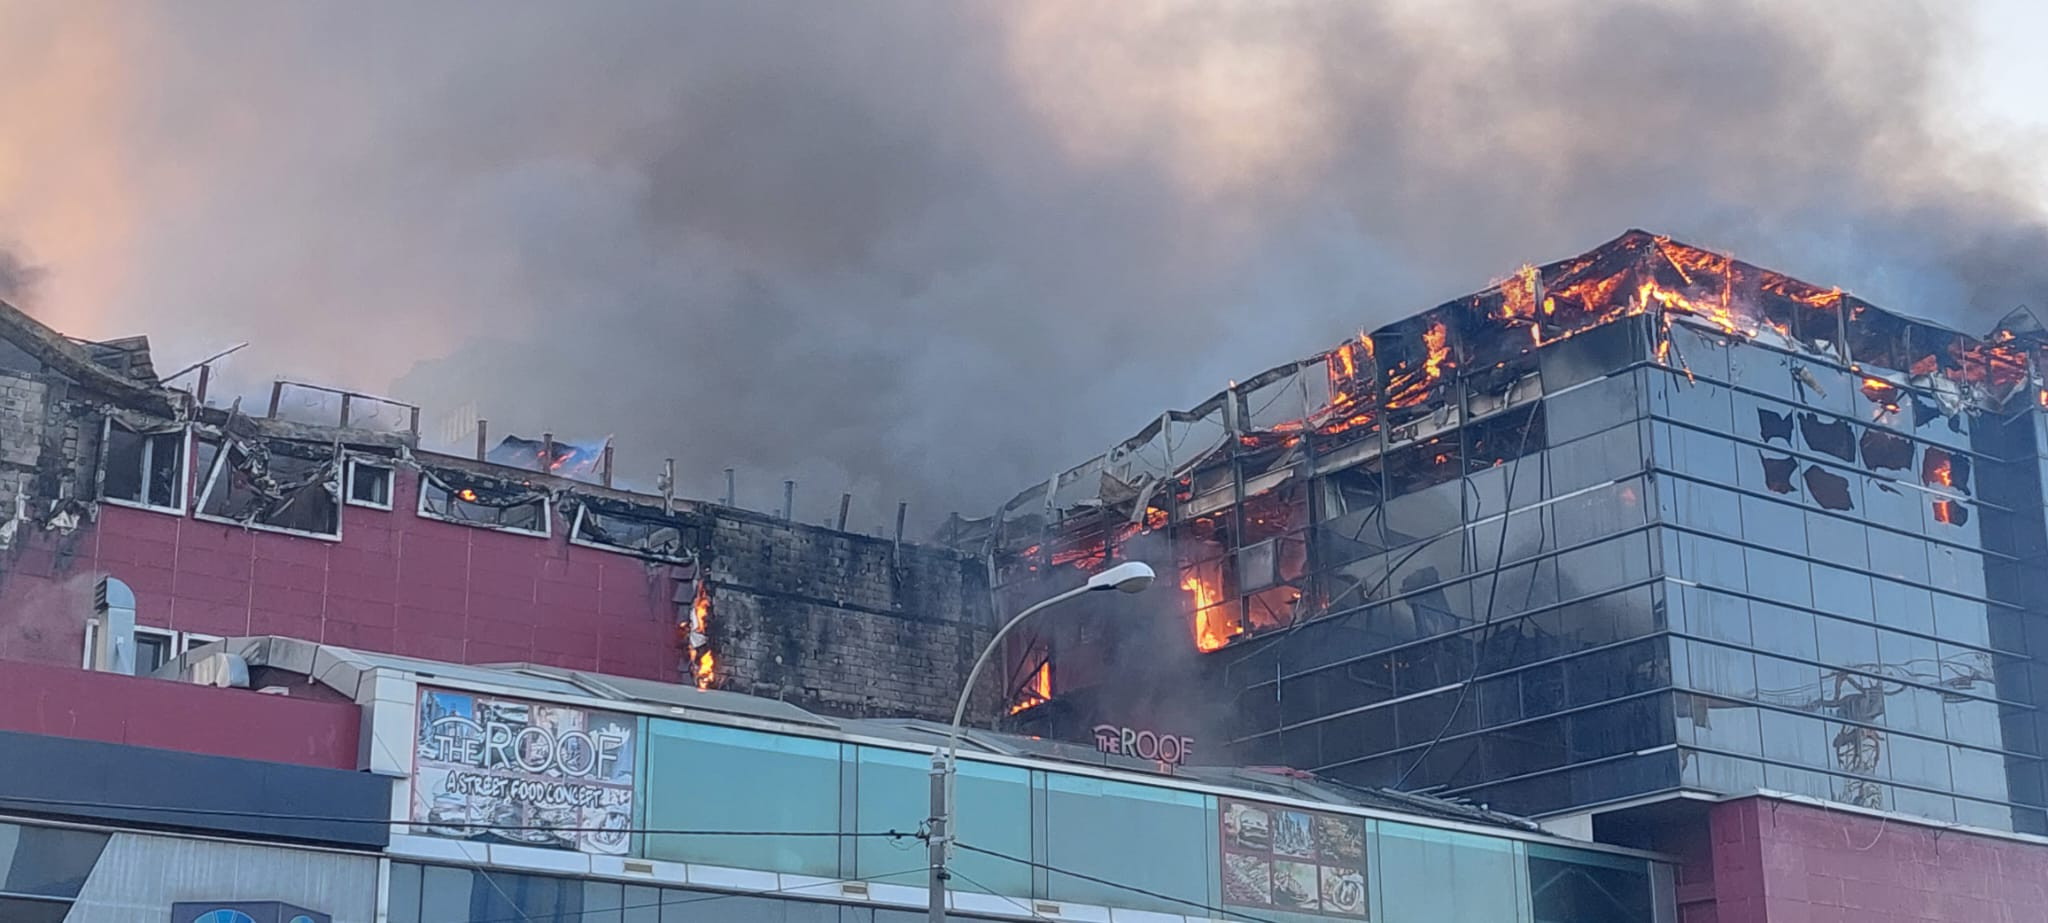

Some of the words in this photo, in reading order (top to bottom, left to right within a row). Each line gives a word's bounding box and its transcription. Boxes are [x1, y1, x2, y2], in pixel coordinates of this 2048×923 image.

[434, 734, 480, 765] THE
[484, 721, 622, 779] ROOF
[1095, 734, 1120, 753] THE
[1121, 727, 1194, 765] ROOF
[445, 770, 457, 793] A
[458, 773, 509, 797] STREET
[510, 779, 544, 801] FOOD
[545, 784, 603, 808] CONCEPT
